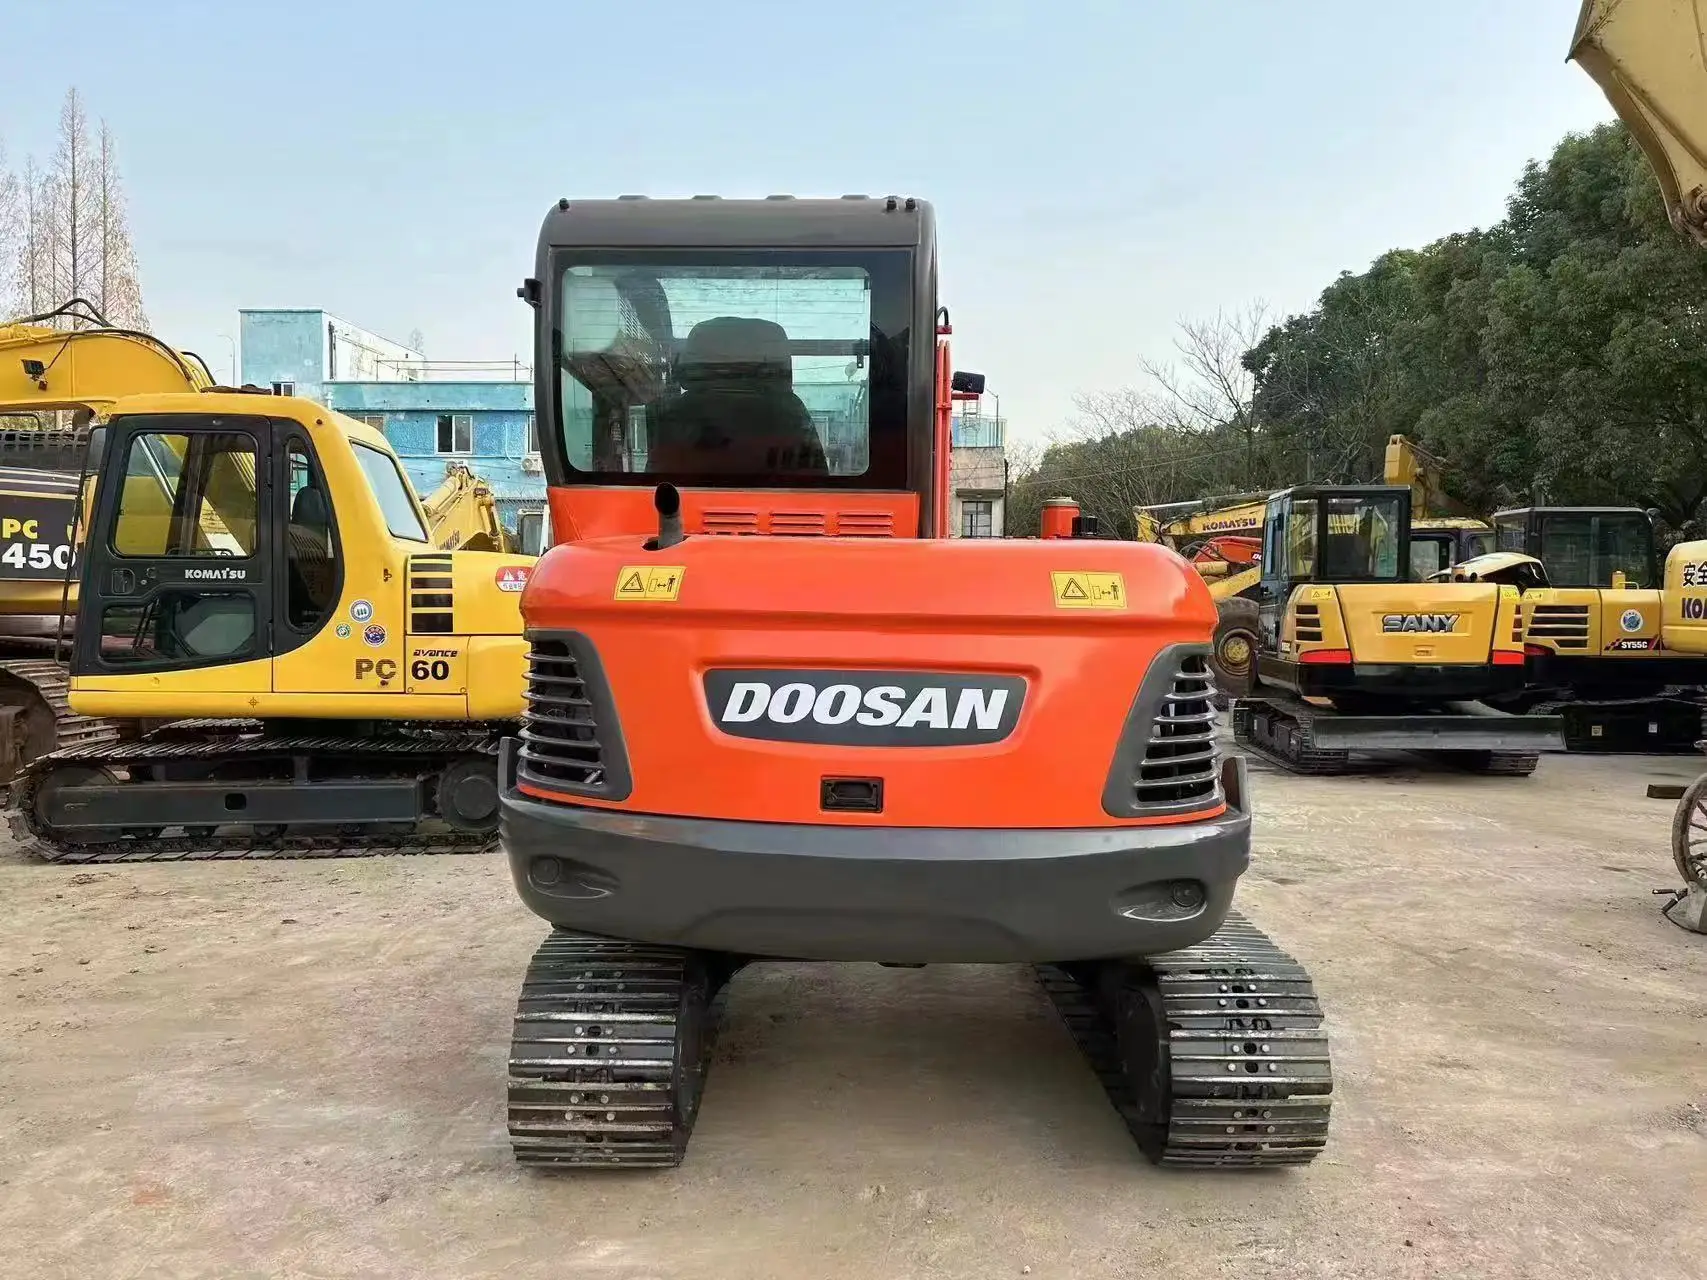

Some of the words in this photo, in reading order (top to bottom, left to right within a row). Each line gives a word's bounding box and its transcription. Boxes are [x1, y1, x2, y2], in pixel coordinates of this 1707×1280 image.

[2, 518, 38, 539] PC
[1202, 517, 1257, 531] KOMATSU
[1, 542, 76, 570] 450
[184, 567, 246, 579] KOMATSU
[1382, 614, 1460, 633] SANY
[1621, 641, 1648, 649] SY55C
[355, 658, 397, 679] PC
[411, 660, 450, 680] 60
[721, 682, 1009, 730] DOOSAN
